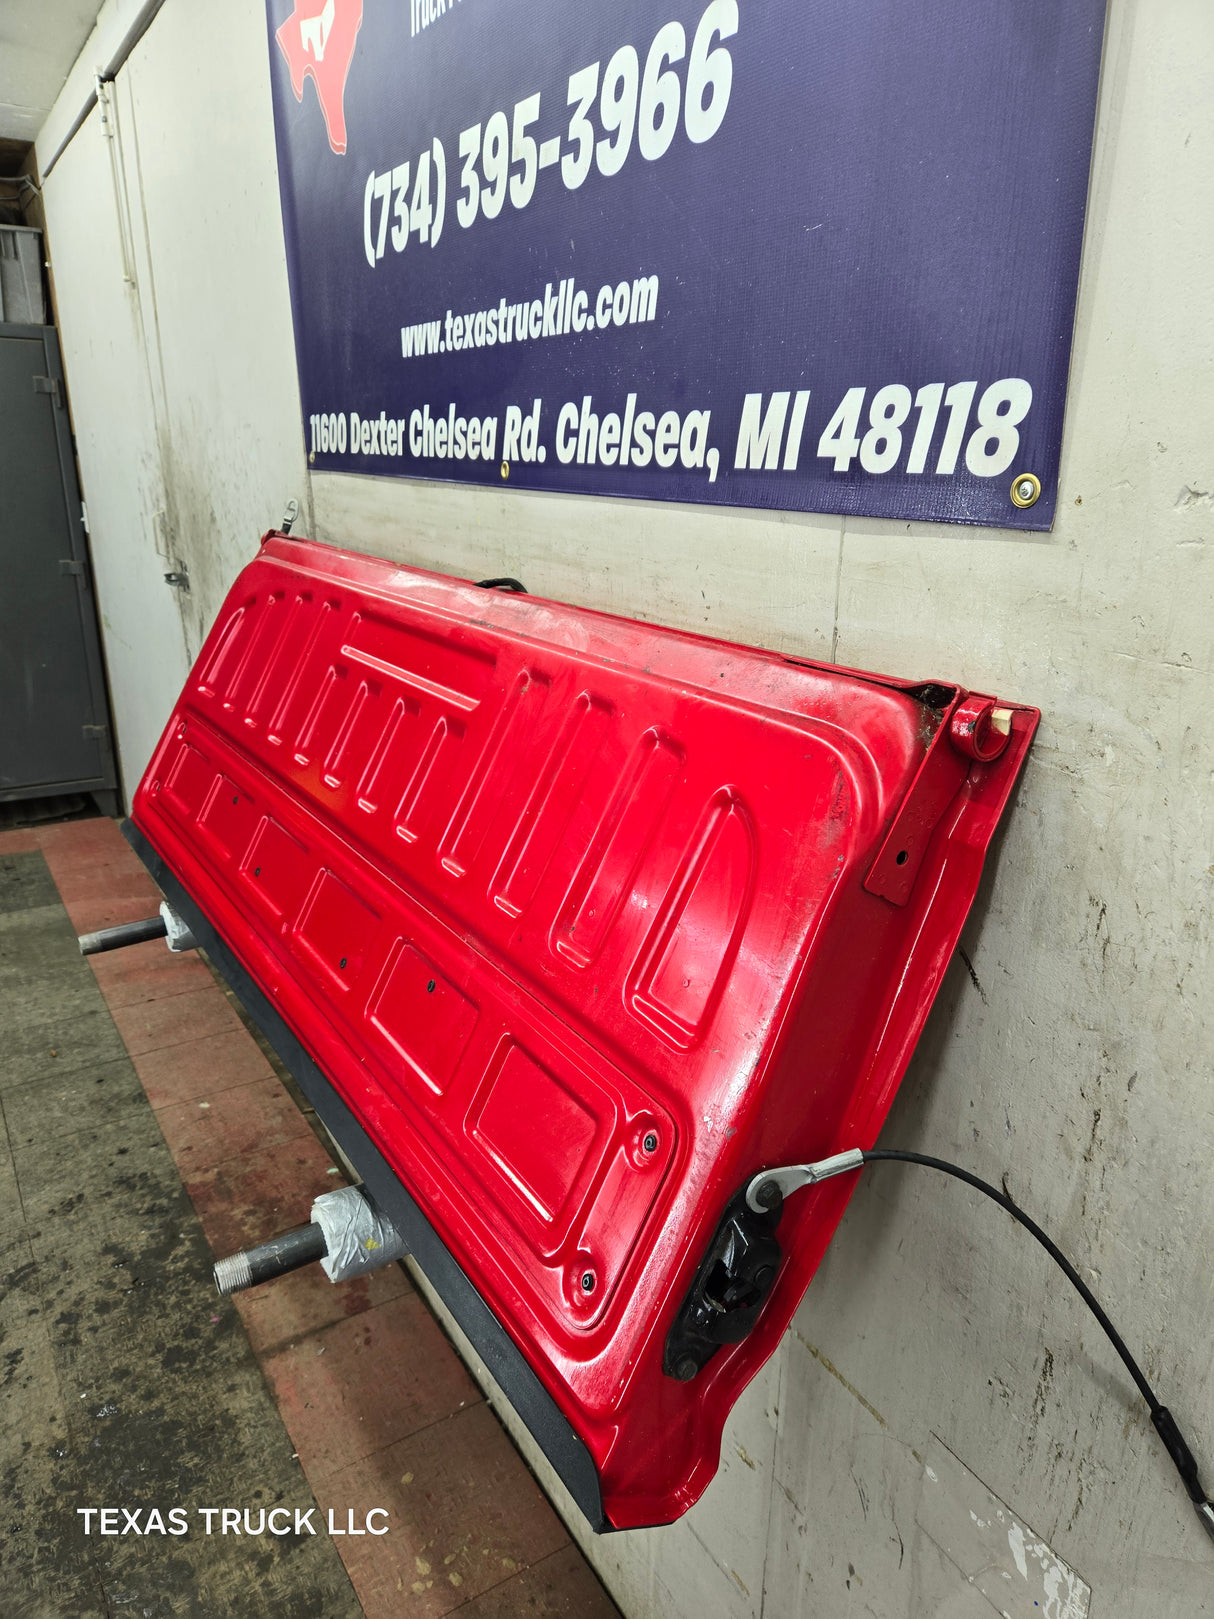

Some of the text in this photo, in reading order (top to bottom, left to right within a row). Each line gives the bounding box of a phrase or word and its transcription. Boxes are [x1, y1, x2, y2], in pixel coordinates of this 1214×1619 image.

[364, 0, 739, 268] (734) 395-3966
[401, 275, 659, 358] www.texastruckllc.com
[309, 378, 1033, 482] 11600 Dexter Chelsea Rd. Chelsea, MI 48118
